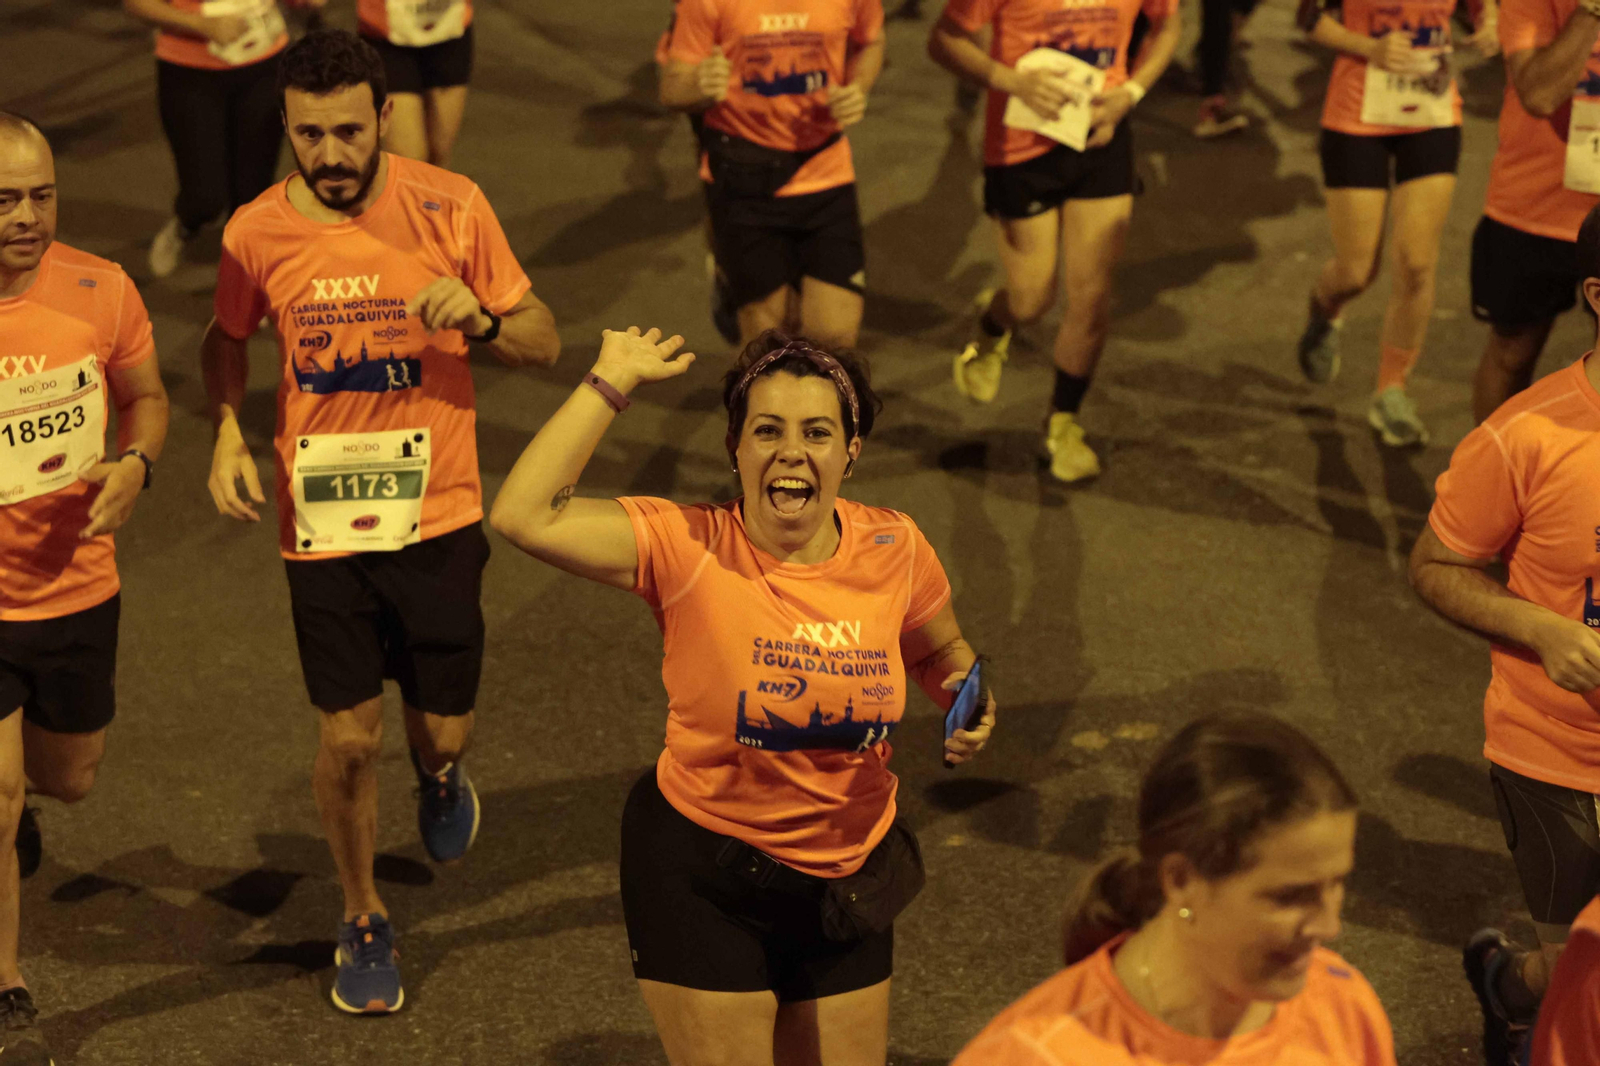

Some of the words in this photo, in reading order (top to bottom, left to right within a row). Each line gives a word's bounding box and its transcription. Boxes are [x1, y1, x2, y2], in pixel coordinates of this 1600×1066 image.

[311, 274, 379, 300] XXXV
[291, 303, 338, 314] CARRERA
[343, 298, 406, 310] NOCTURNA
[299, 309, 407, 326] GUADALQUIVIR
[1, 405, 86, 447] 18523
[330, 473, 399, 498] 1173
[792, 620, 861, 648] XXXV
[1586, 617, 1600, 627] 20
[754, 637, 821, 657] CARRERA
[828, 649, 888, 661] NOCTURNA
[763, 653, 891, 677] GUADALQUIVIR
